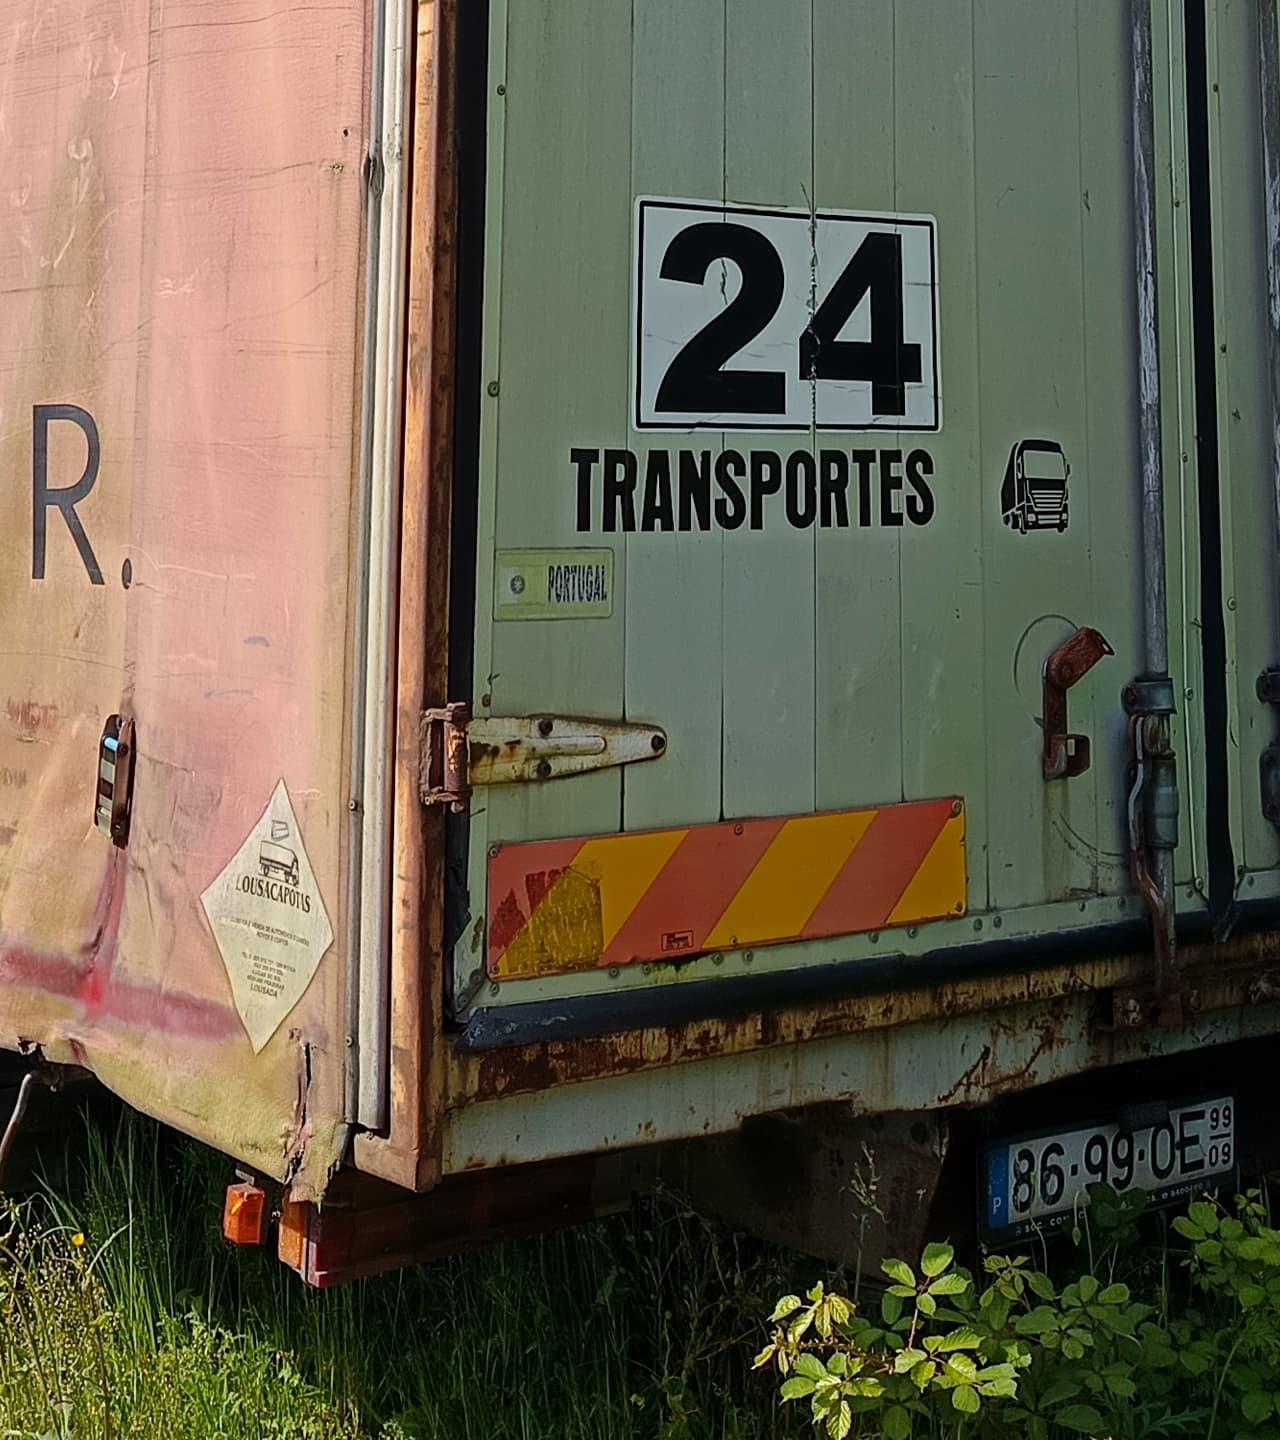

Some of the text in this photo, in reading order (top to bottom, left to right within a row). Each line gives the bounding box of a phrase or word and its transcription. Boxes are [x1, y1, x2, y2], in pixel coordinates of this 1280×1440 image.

[653, 221, 923, 416] 24
[569, 447, 936, 533] TRANSPORTES
[547, 563, 608, 603] PORTUGAL
[1208, 1104, 1232, 1131] 99
[1208, 1142, 1232, 1168] 09
[993, 1196, 1002, 1215] P
